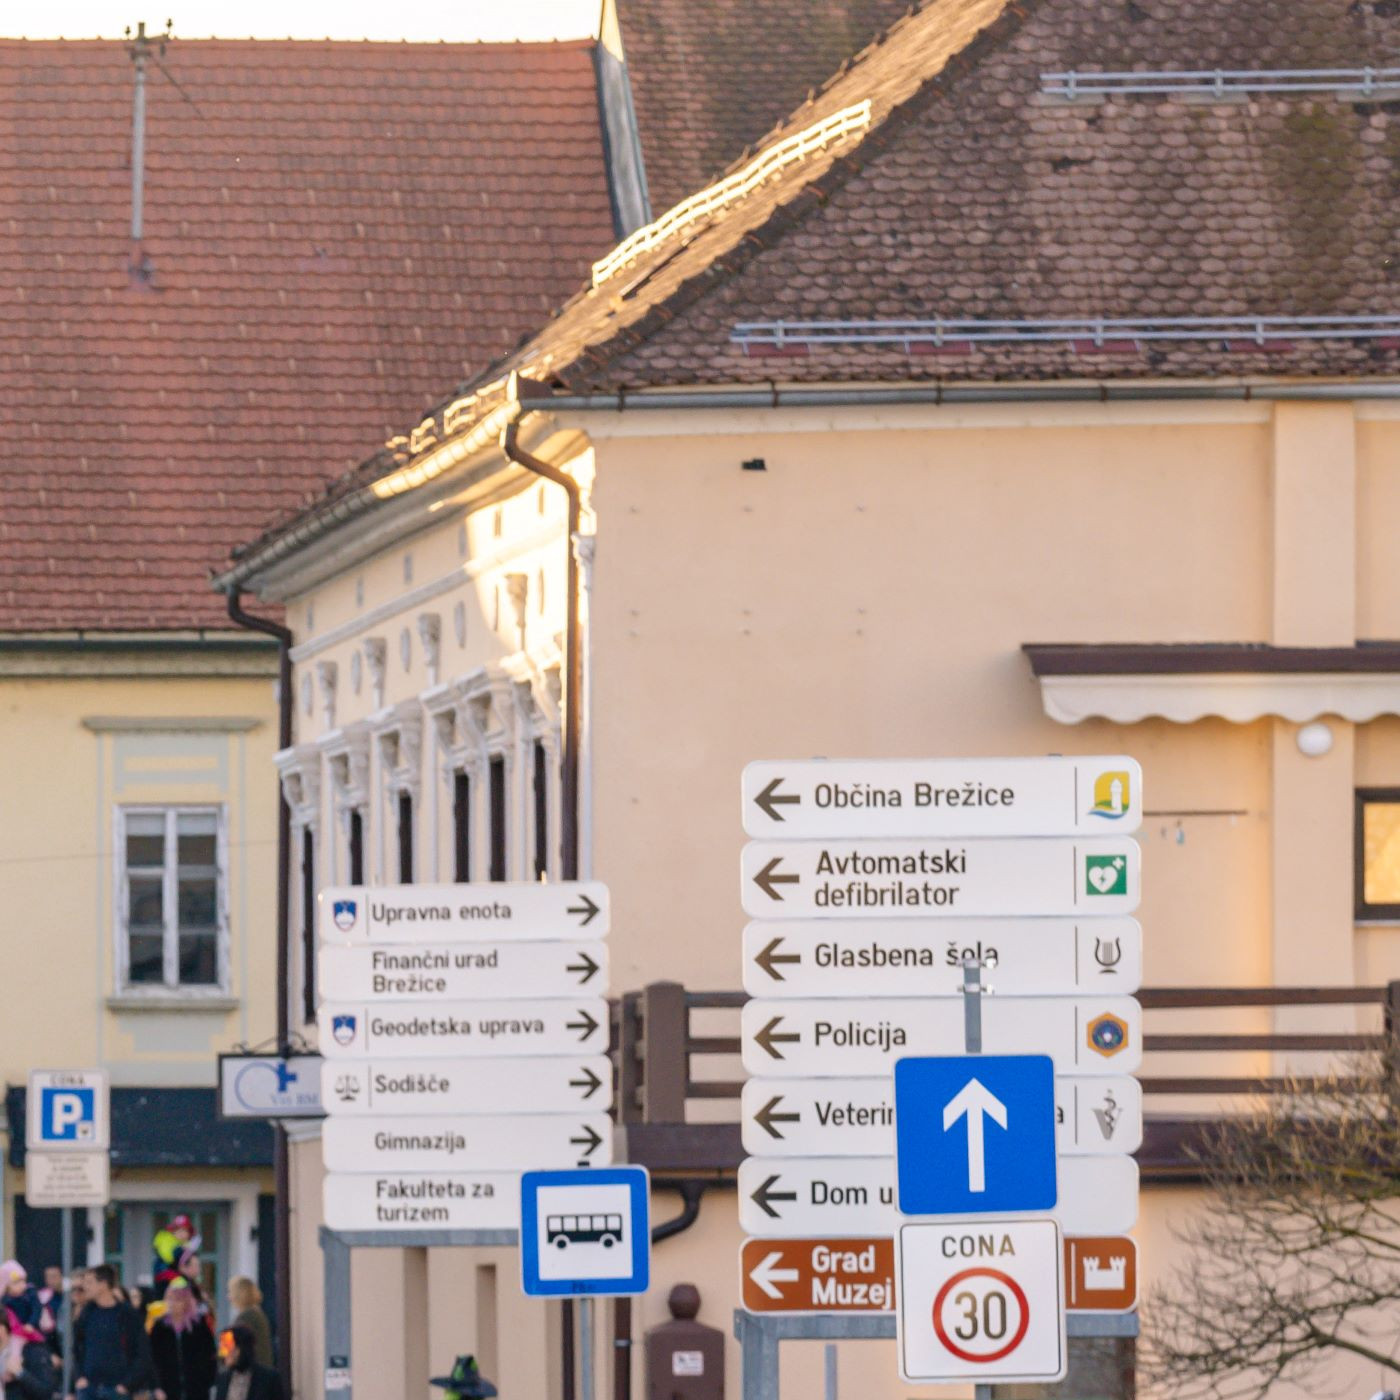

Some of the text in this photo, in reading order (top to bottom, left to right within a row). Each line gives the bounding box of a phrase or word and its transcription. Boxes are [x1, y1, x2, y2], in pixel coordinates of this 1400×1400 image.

[814, 780, 1015, 809] Občina Brežice
[815, 849, 967, 875] Avtomatski
[814, 881, 960, 907] defibrilator
[372, 902, 512, 926] Upravna enota
[372, 949, 498, 970] Finančni urad
[815, 940, 999, 968] Glasbena šola
[372, 973, 446, 993] Brežice
[371, 1016, 545, 1039] Geodetska uprava
[814, 1021, 906, 1053] Policija
[375, 1073, 450, 1094] Sodišče
[52, 1093, 83, 1136] P
[374, 1131, 466, 1154] Gimnazija
[375, 1179, 495, 1199] Fakulteta za
[811, 1180, 868, 1205] Dom
[376, 1204, 449, 1222] turizem
[941, 1233, 1016, 1259] CONA
[811, 1245, 876, 1274] Grad
[811, 1277, 893, 1310] Muzej
[953, 1291, 1007, 1341] 30
